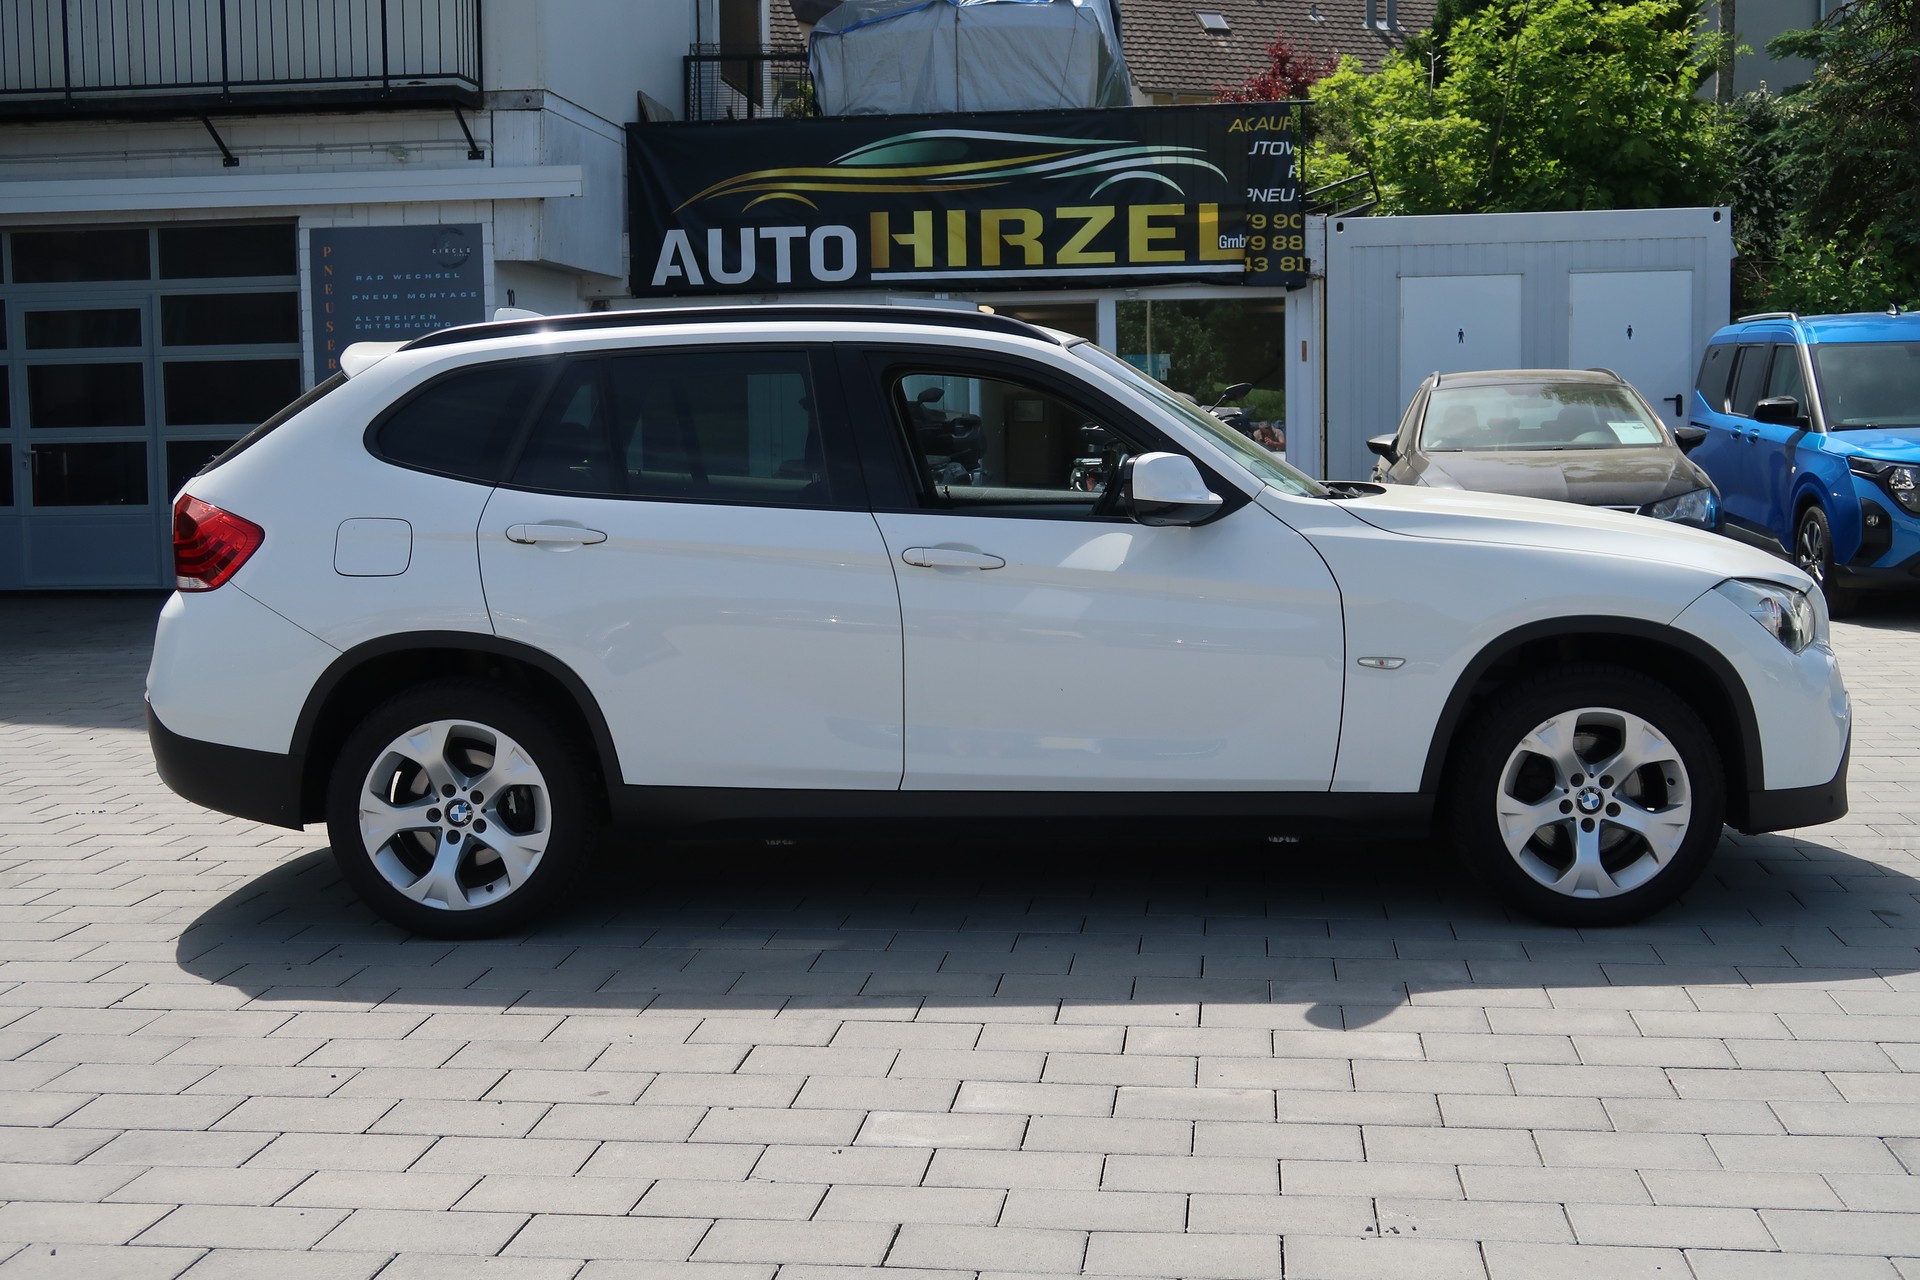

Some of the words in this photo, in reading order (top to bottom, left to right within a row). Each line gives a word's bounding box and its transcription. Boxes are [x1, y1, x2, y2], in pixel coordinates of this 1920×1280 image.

[651, 225, 857, 286] AUTO
[870, 203, 1245, 268] HIRZEL
[1272, 235, 1303, 250] 88
[1280, 256, 1305, 272] 81
[507, 289, 515, 306] 10
